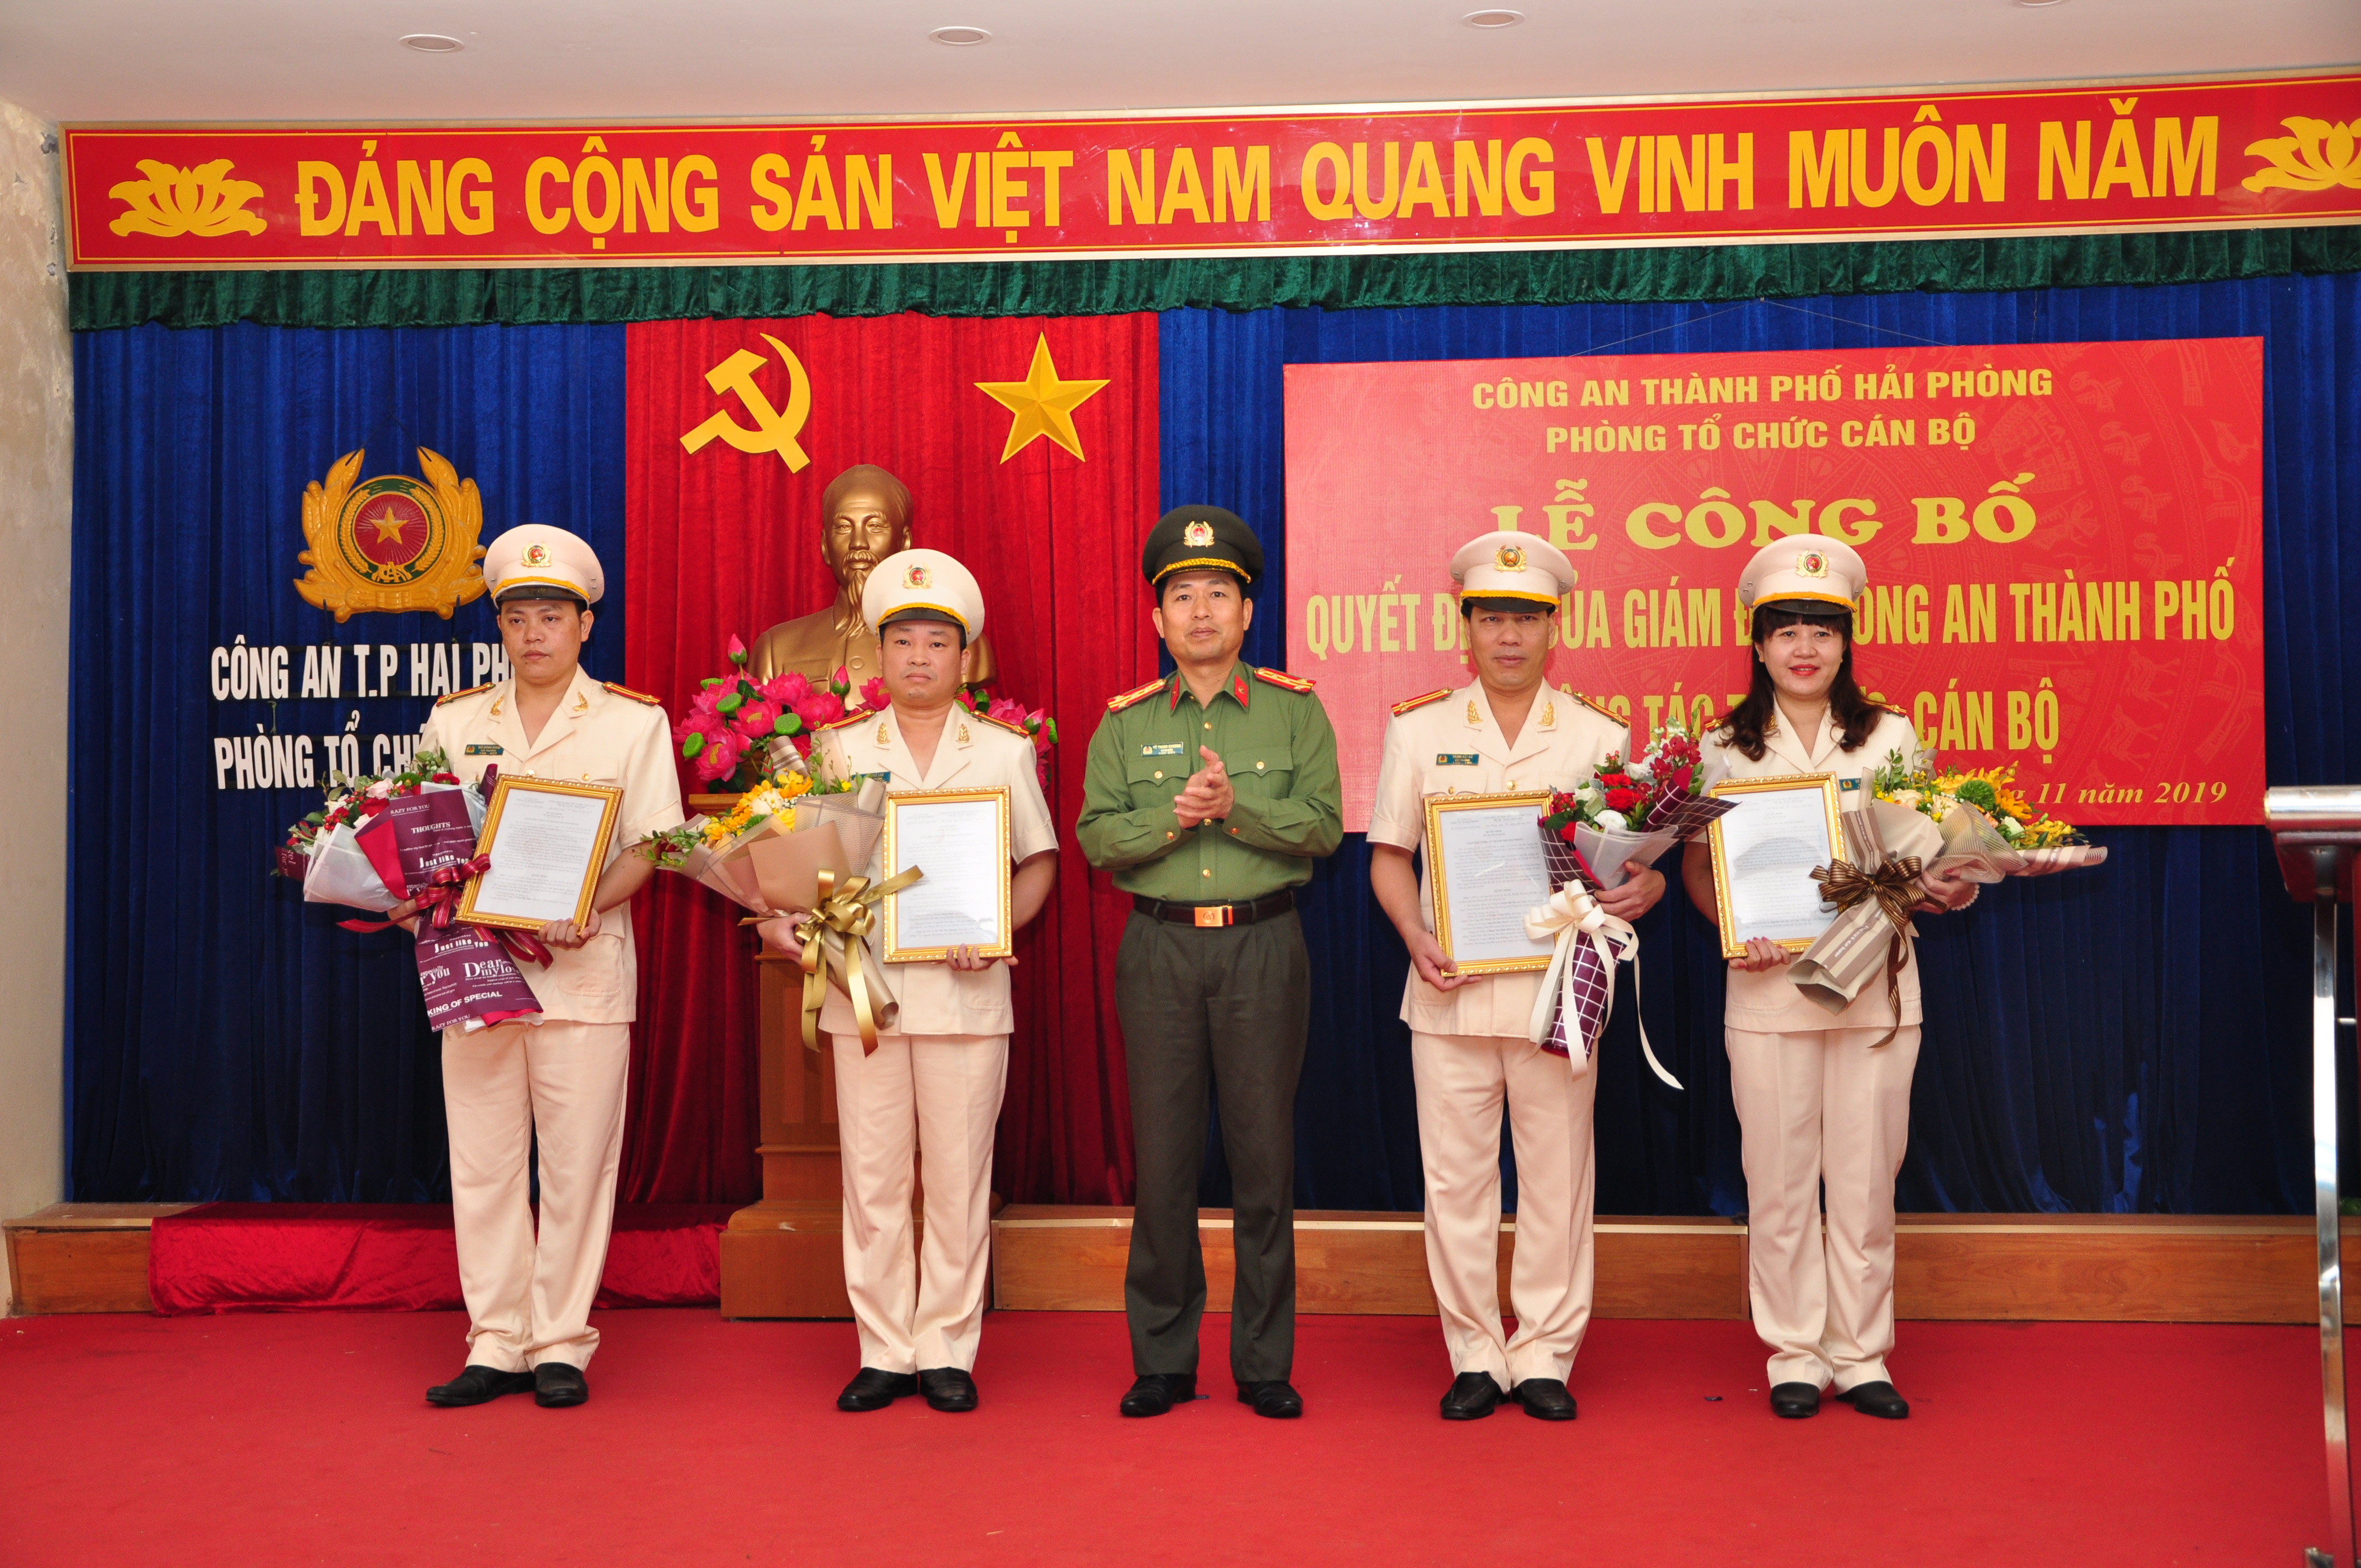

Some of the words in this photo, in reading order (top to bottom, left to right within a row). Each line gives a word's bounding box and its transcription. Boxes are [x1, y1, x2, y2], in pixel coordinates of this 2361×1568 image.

[295, 140, 494, 236] ĐẢNG
[525, 136, 719, 249] CỘNG
[750, 135, 893, 231] SẢN
[923, 131, 1074, 243] VIỆT
[1107, 145, 1271, 225] NAM
[1301, 137, 1554, 221] QUANG
[1586, 133, 1754, 214] VINH
[1789, 105, 2006, 209] MUÔN
[2038, 97, 2219, 200] NĂM
[1473, 377, 1568, 409] CÔNG
[1580, 380, 1629, 406] AN
[1640, 372, 1758, 405] THÀNH
[1771, 364, 1842, 401] PHỐ
[1854, 364, 1914, 400] HẢI
[1927, 363, 2053, 398] PHÒNG
[1547, 420, 1666, 453] PHÒNG
[1678, 413, 1722, 450] TỔ
[1733, 416, 1828, 449] CHỨC
[1841, 414, 1916, 447] CÁN
[1928, 412, 1976, 451] BỘ
[1626, 487, 1883, 549] CÔNG
[1912, 472, 2037, 544] BỐ
[1306, 574, 1421, 661] QUYẾT
[1432, 593, 1470, 665] ĐỊ
[1548, 569, 1612, 650] ỦA
[1624, 575, 1722, 648] GIÁM
[1852, 576, 1929, 646] ÔNG
[1943, 584, 1997, 644] AN
[2010, 569, 2141, 643] THÀNH
[2155, 557, 2235, 640] PHỐ
[211, 634, 289, 701] CÔNG
[301, 645, 342, 698] AN
[353, 644, 399, 698] T.P
[1913, 678, 1994, 751] CÁN
[2007, 677, 2060, 764] BỘ
[214, 723, 315, 790] PHÒNG
[323, 710, 361, 788] TỔ
[2037, 782, 2067, 804] 11
[2078, 783, 2144, 804] năm
[2153, 782, 2228, 804] 2019
[411, 821, 451, 834] THOUGHTS
[419, 857, 438, 869] Just
[439, 854, 455, 864] like
[434, 943, 454, 954] Just
[455, 938, 472, 947] like
[429, 967, 450, 985] you
[462, 958, 502, 978] Dear
[427, 1003, 449, 1016] KING
[450, 998, 463, 1009] OF
[464, 990, 503, 1004] SPECIAL
[458, 1014, 471, 1022] YOU
